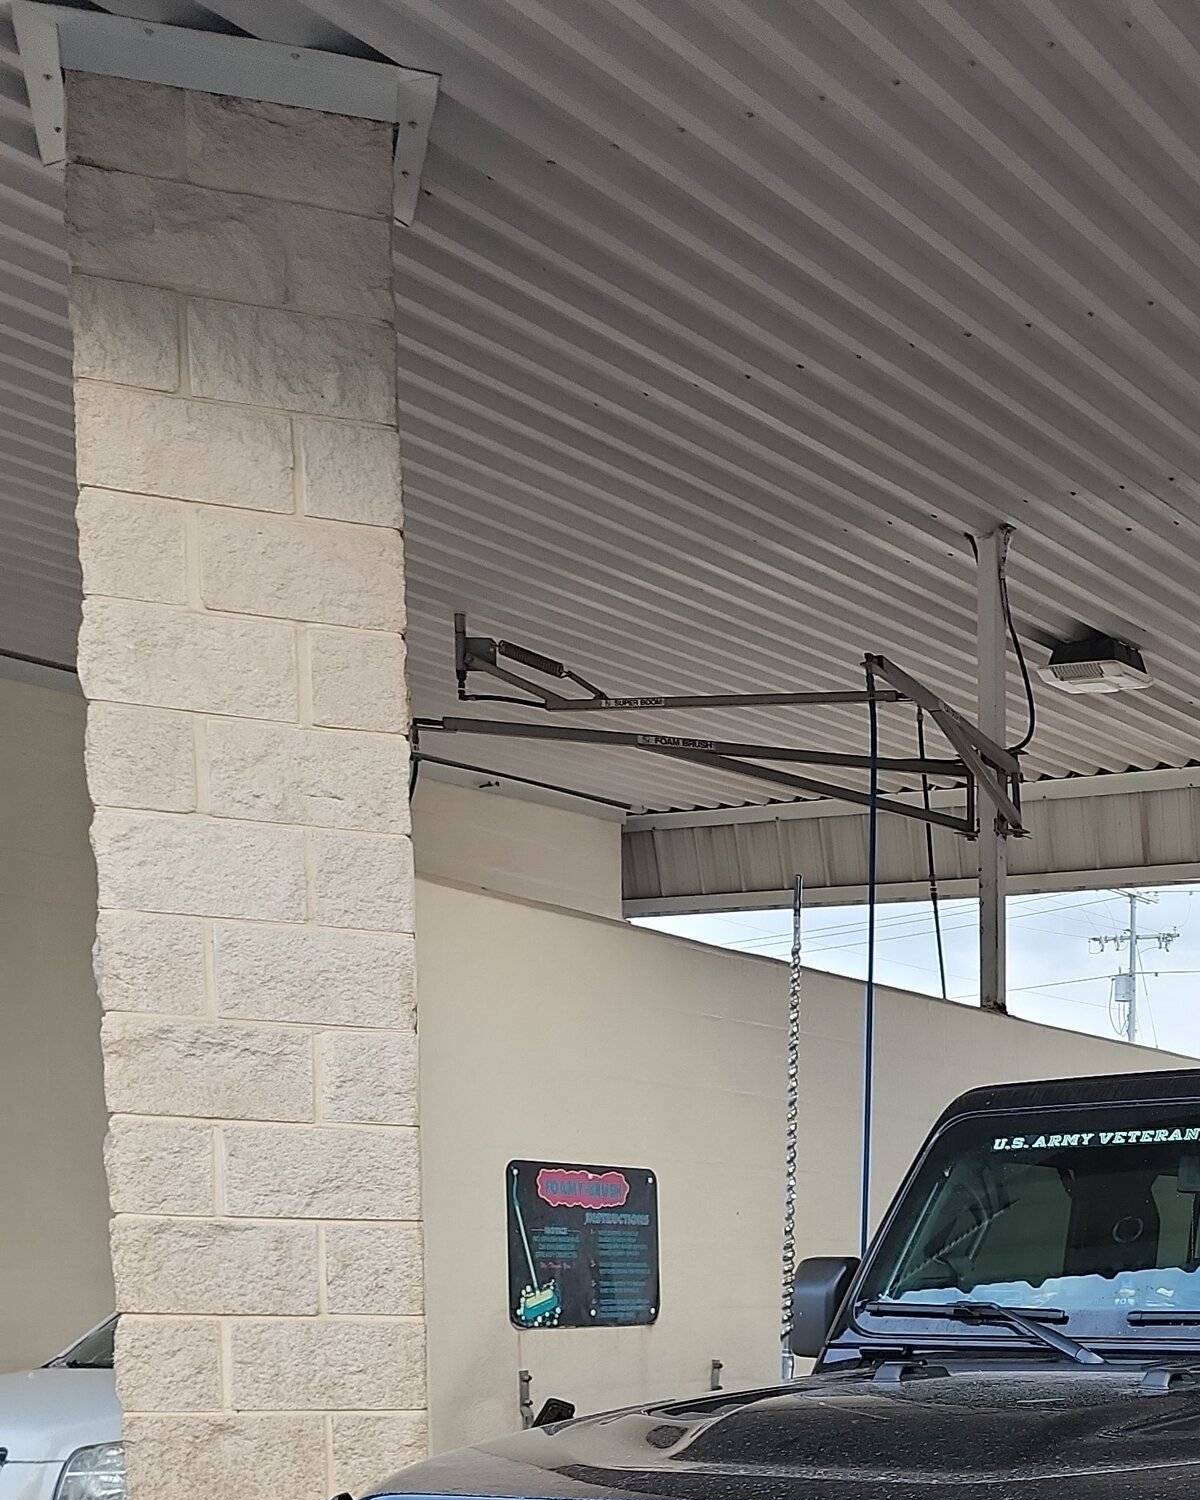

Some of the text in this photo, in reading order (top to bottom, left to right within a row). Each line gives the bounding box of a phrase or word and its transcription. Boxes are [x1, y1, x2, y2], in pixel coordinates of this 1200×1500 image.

[614, 698, 663, 707] SUPER BOOM
[654, 737, 713, 750] FOAM BRUSH
[993, 1127, 1200, 1150] U.S. ARMY VETERAN
